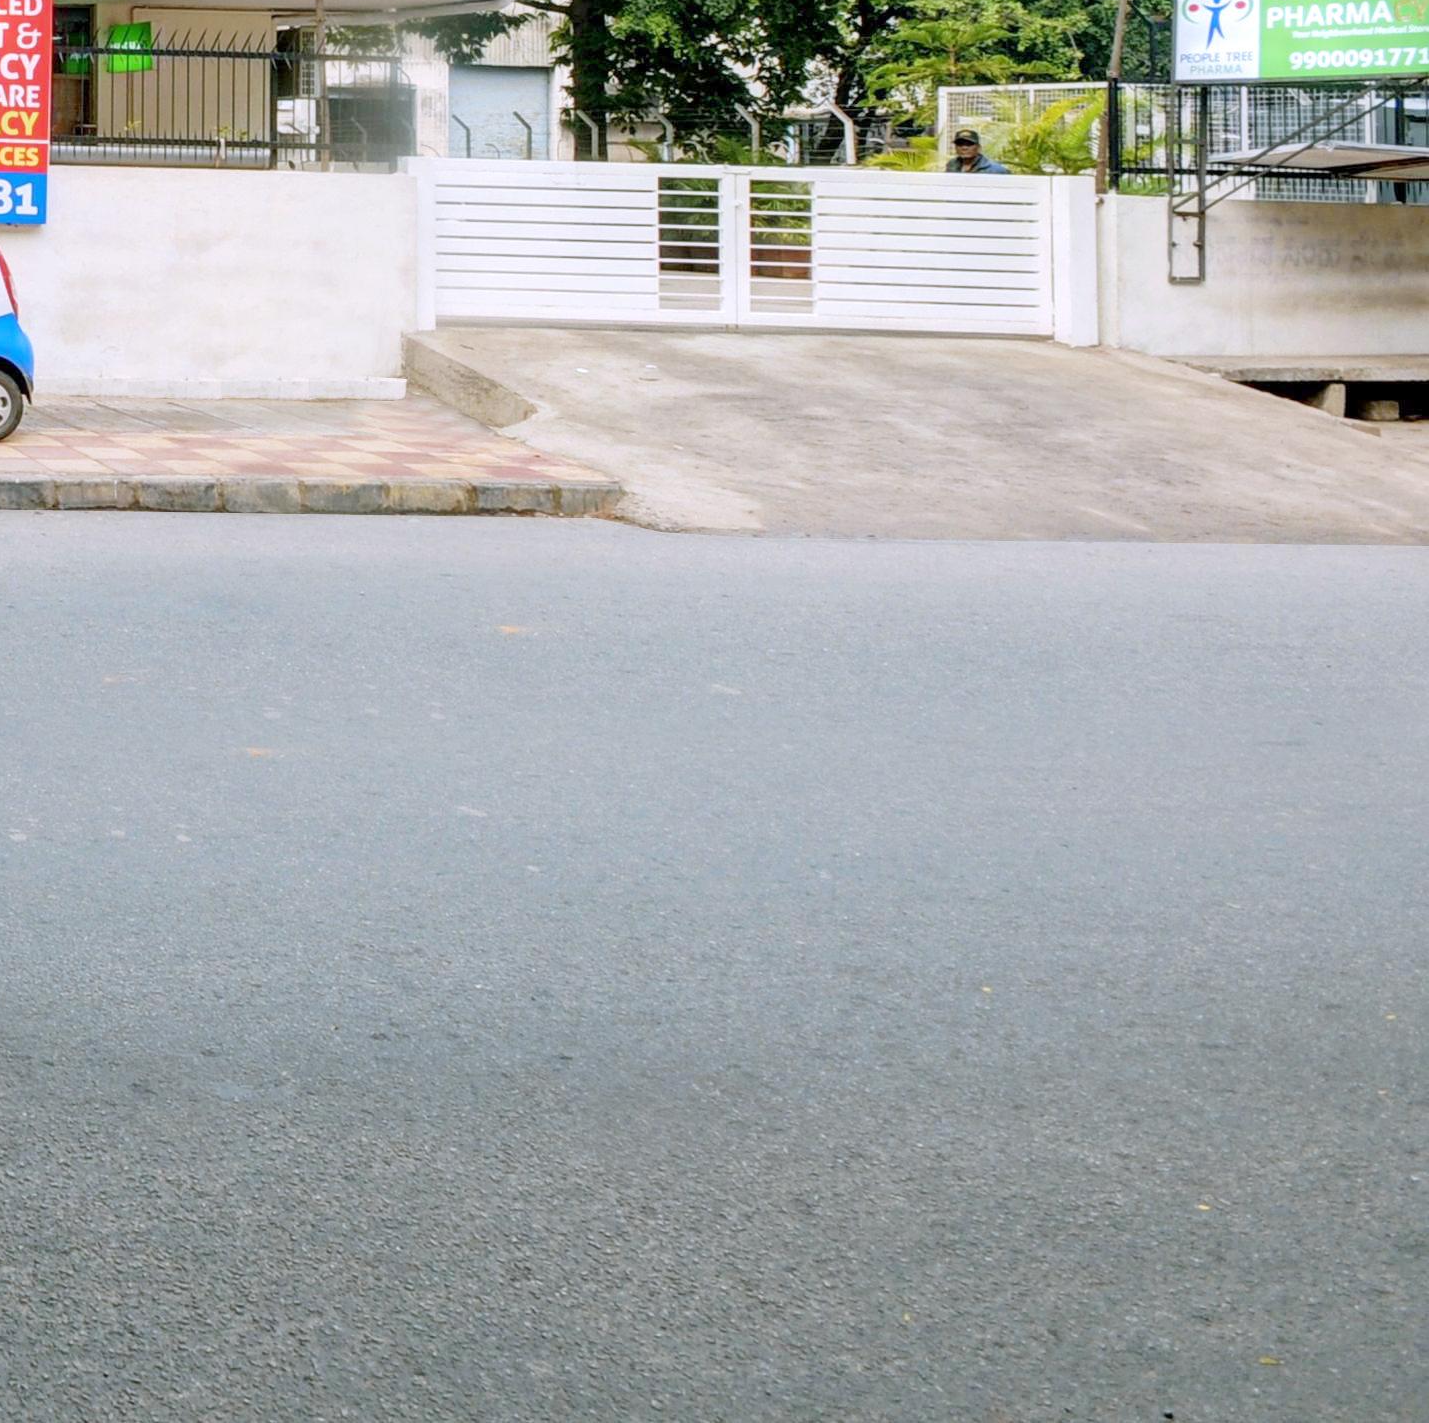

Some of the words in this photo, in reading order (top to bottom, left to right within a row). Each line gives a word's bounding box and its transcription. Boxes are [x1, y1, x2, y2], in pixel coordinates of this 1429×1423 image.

[16, 22, 41, 49] &
[1180, 52, 1220, 63] PEOPLE
[1226, 51, 1253, 62] TREE
[1190, 64, 1242, 74] PHARMA
